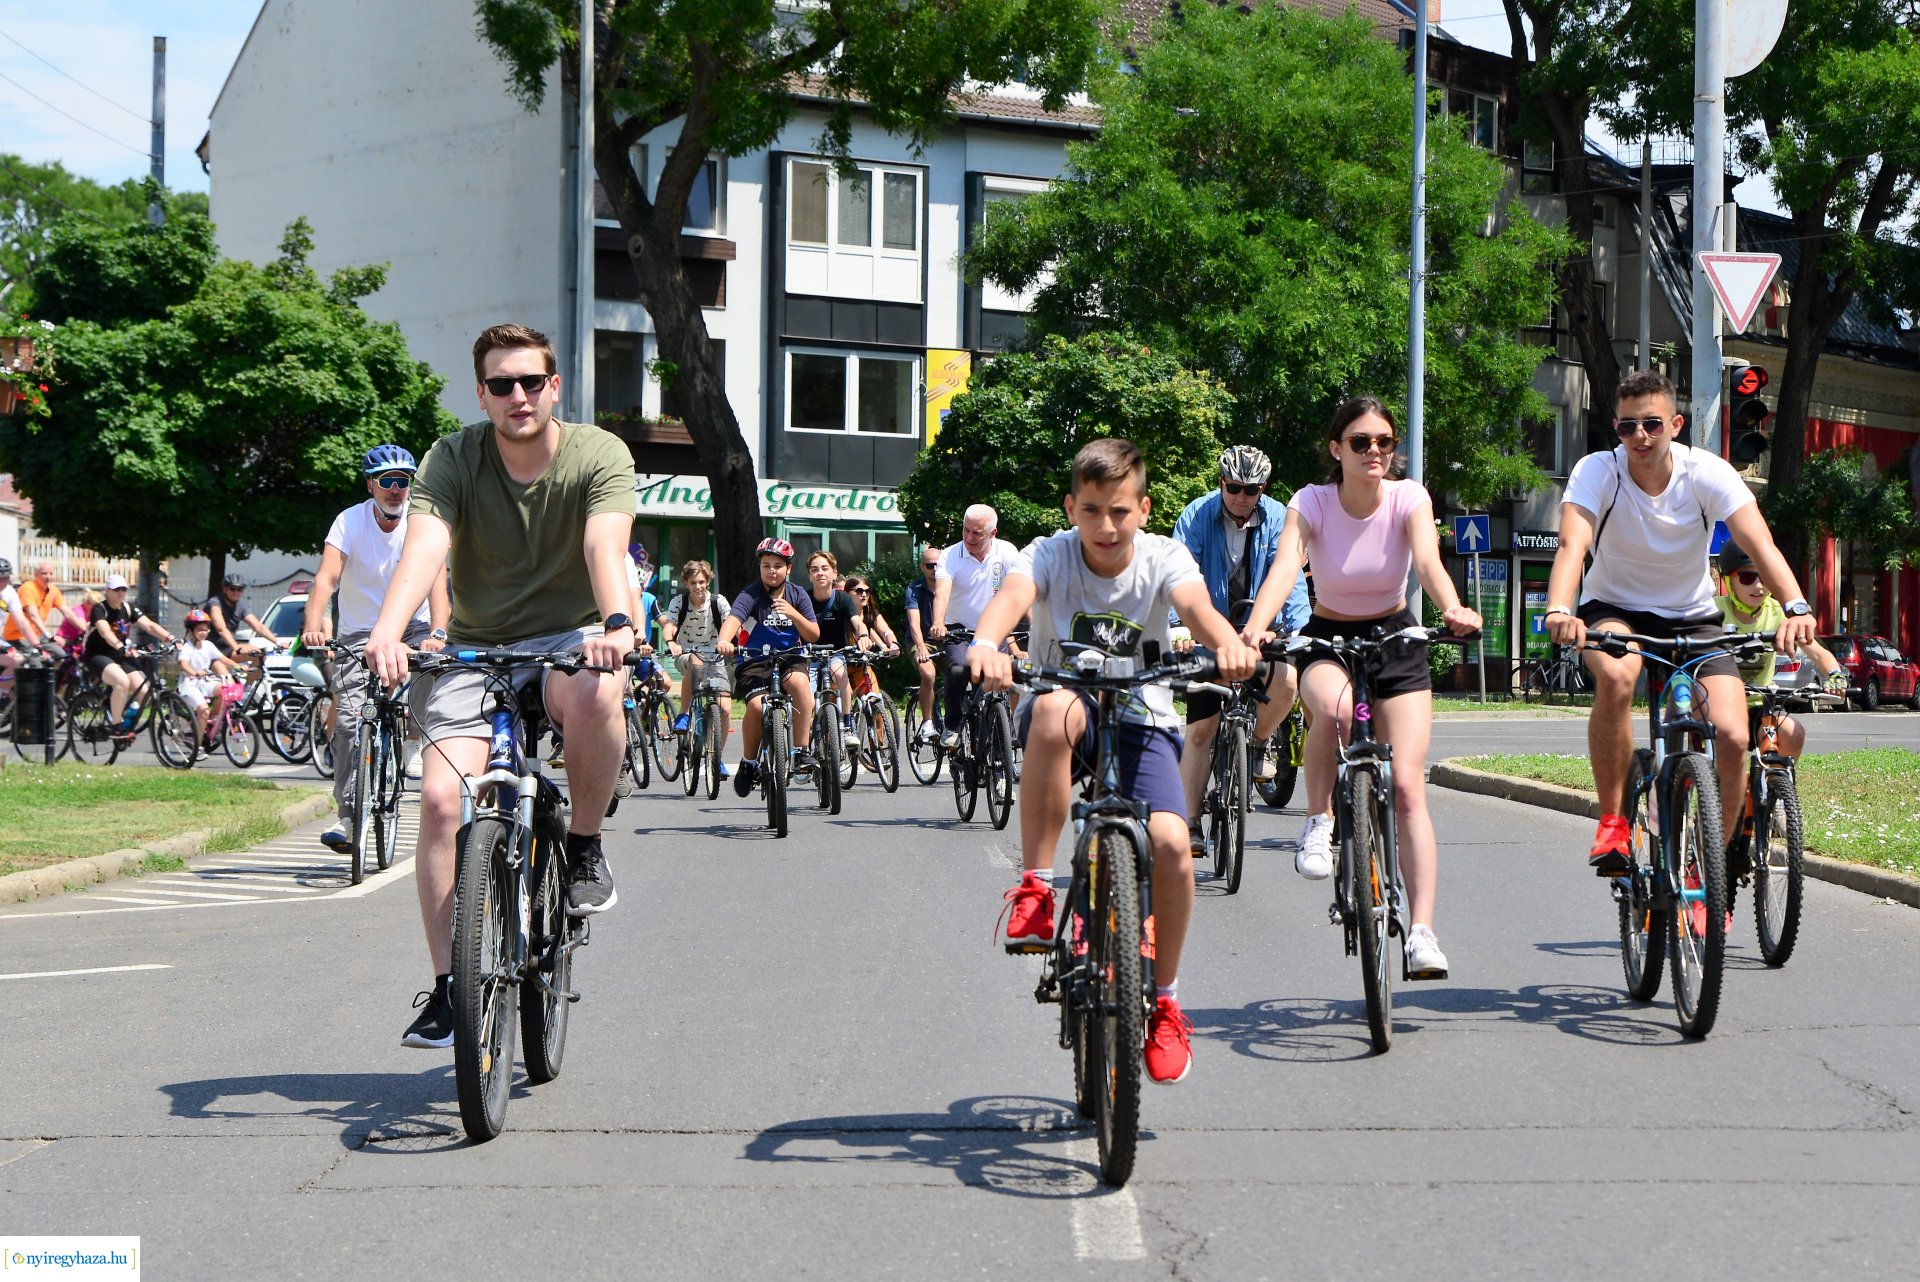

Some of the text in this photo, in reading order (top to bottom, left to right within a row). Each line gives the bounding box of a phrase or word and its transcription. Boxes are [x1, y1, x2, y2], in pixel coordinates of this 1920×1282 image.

[641, 479, 896, 514] Ang Gardró
[1527, 593, 1546, 601] HEP
[763, 618, 793, 627] adidas
